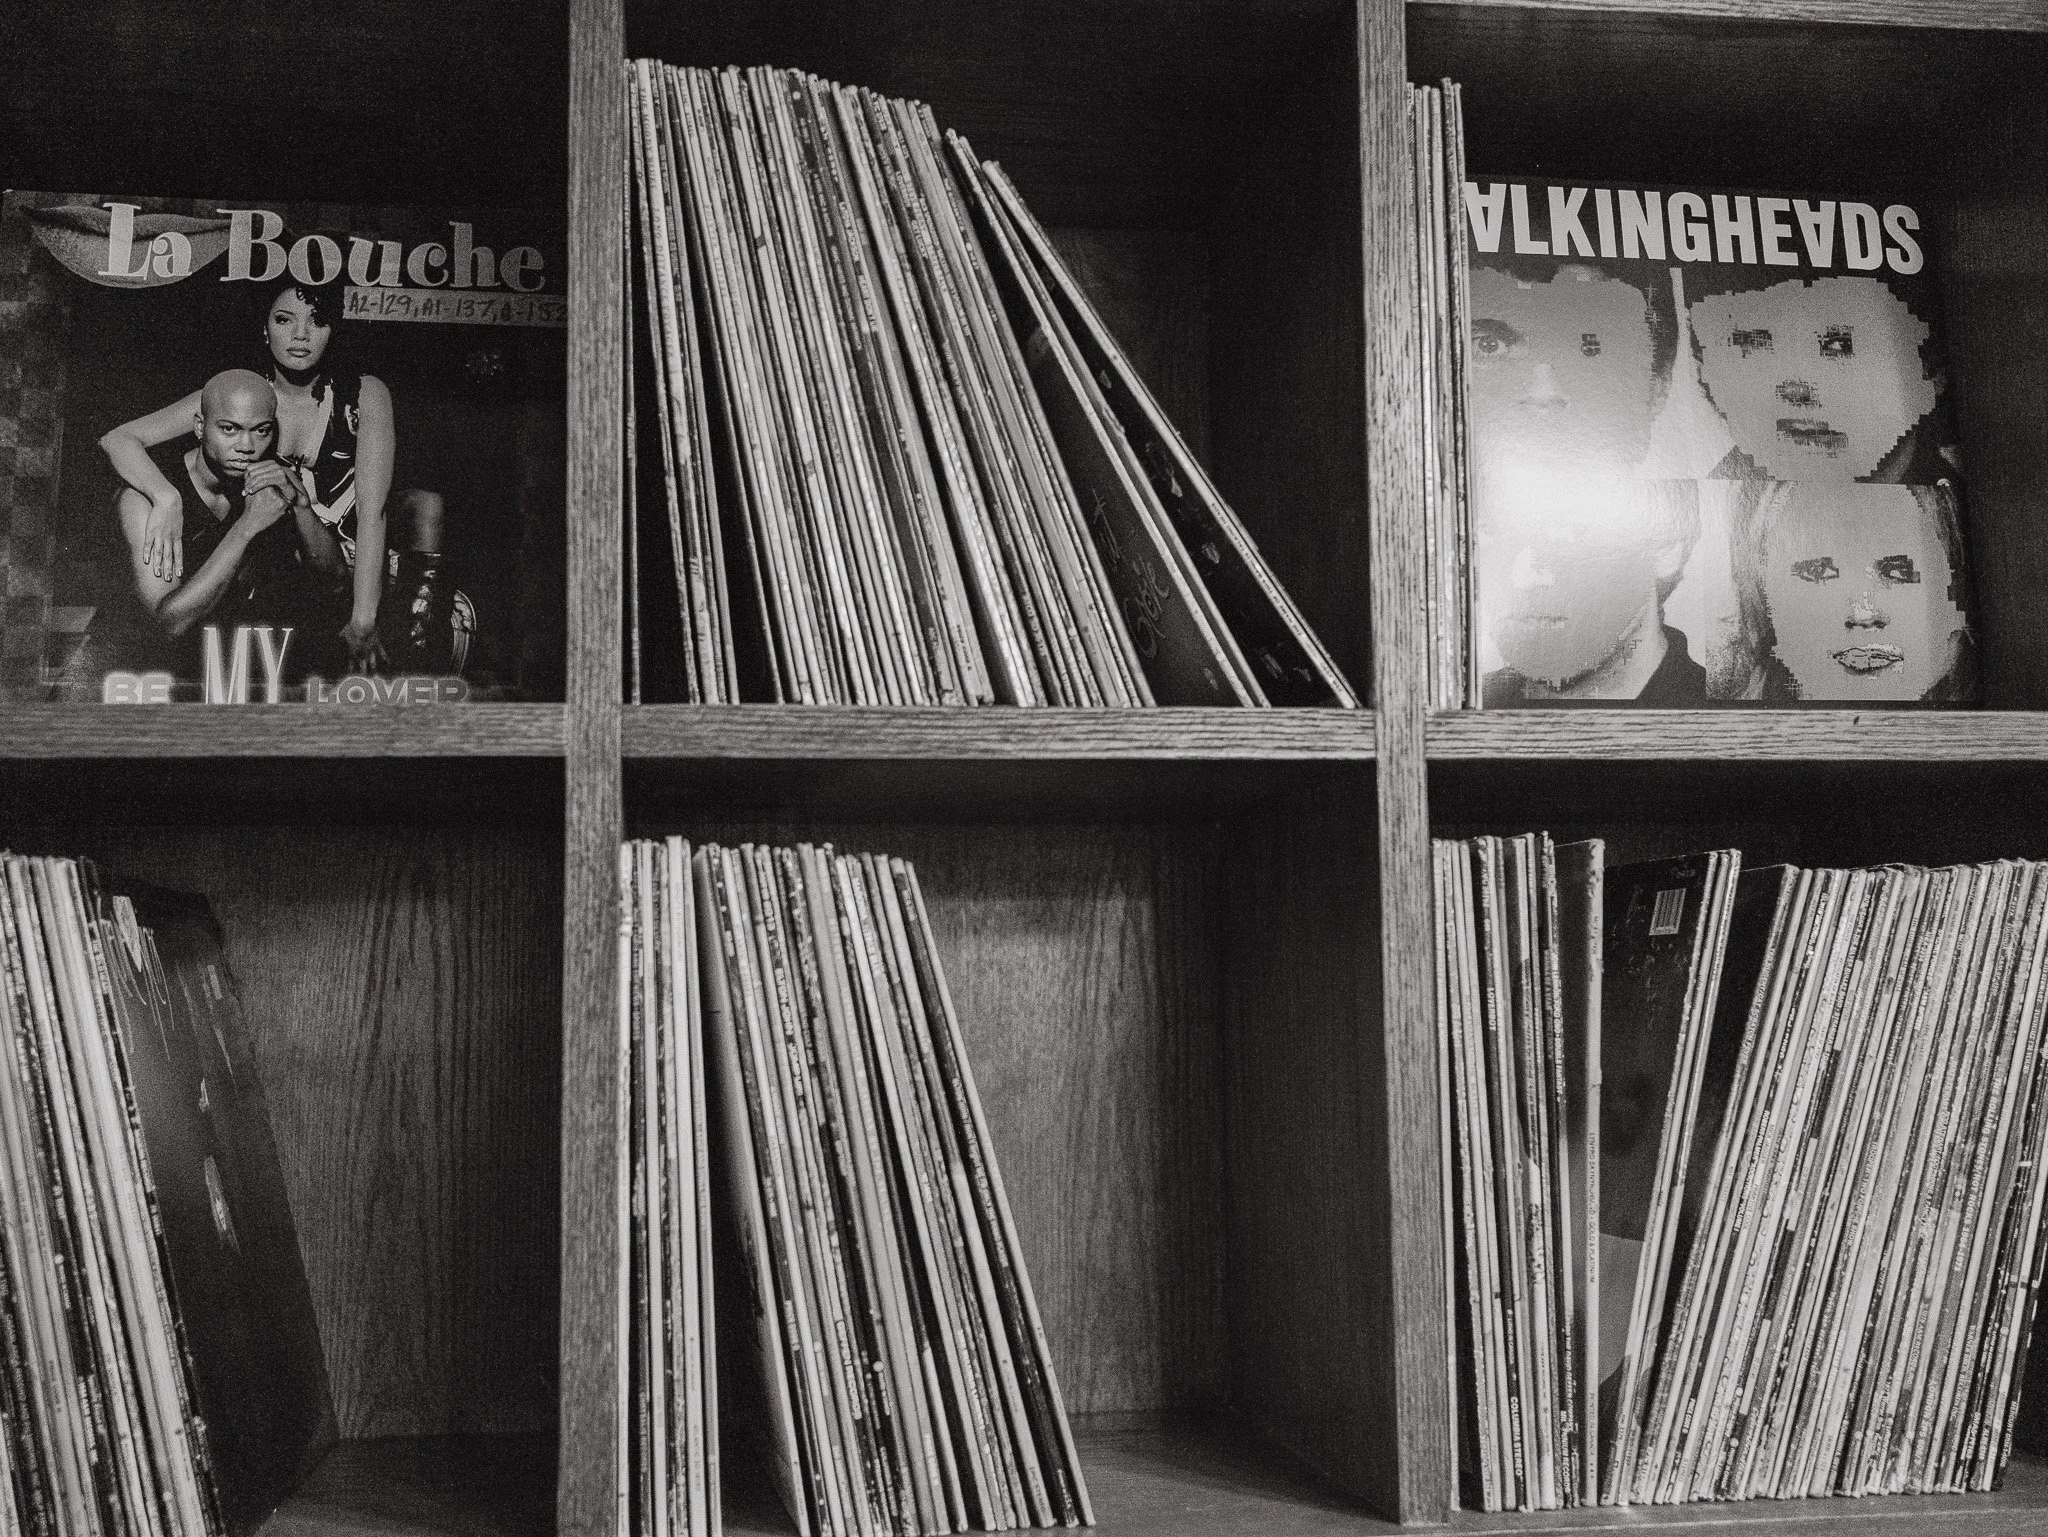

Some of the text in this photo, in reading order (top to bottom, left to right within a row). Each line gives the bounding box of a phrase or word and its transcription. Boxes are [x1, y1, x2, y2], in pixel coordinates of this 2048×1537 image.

[97, 202, 546, 292] La Bouche
[104, 628, 468, 703] BE MY LOVER
[850, 876, 868, 920] MADONNA
[1766, 946, 1776, 961] TED
[773, 967, 788, 1003] ELTON
[2034, 971, 2047, 1004] STEWART
[779, 1002, 793, 1035] JOHN
[1486, 987, 1496, 1031] LOVERBOY
[1746, 1008, 1760, 1041] SCRATCH
[2027, 1007, 2040, 1039] TONIGHT
[786, 1042, 800, 1076] JUMP
[1739, 1041, 1752, 1065] FEVER
[2020, 1050, 2031, 1075] YOURS
[1991, 1077, 2003, 1092] THE
[1757, 1109, 1771, 1135] ROBERT
[1982, 1093, 1999, 1134] ROLLING
[1863, 1140, 1879, 1174] TROOPER
[1858, 1177, 1870, 1195] TWO
[1733, 1202, 1747, 1229] VOLUME
[1963, 1192, 1978, 1225] ROCKS
[1845, 1223, 1858, 1246] SHOW
[1953, 1225, 1971, 1273] 1964-1971
[836, 1319, 852, 1365] GEFFEN
[1963, 1323, 1976, 1353] WARNER
[844, 1365, 862, 1420] RECORDS
[1921, 1379, 1936, 1416] LONDON
[1509, 1396, 1520, 1441] COLUMBIA
[2004, 1399, 2017, 1432] MERCURY
[1512, 1441, 1523, 1476] STEREO
[1561, 1457, 1571, 1493] RECORDS
